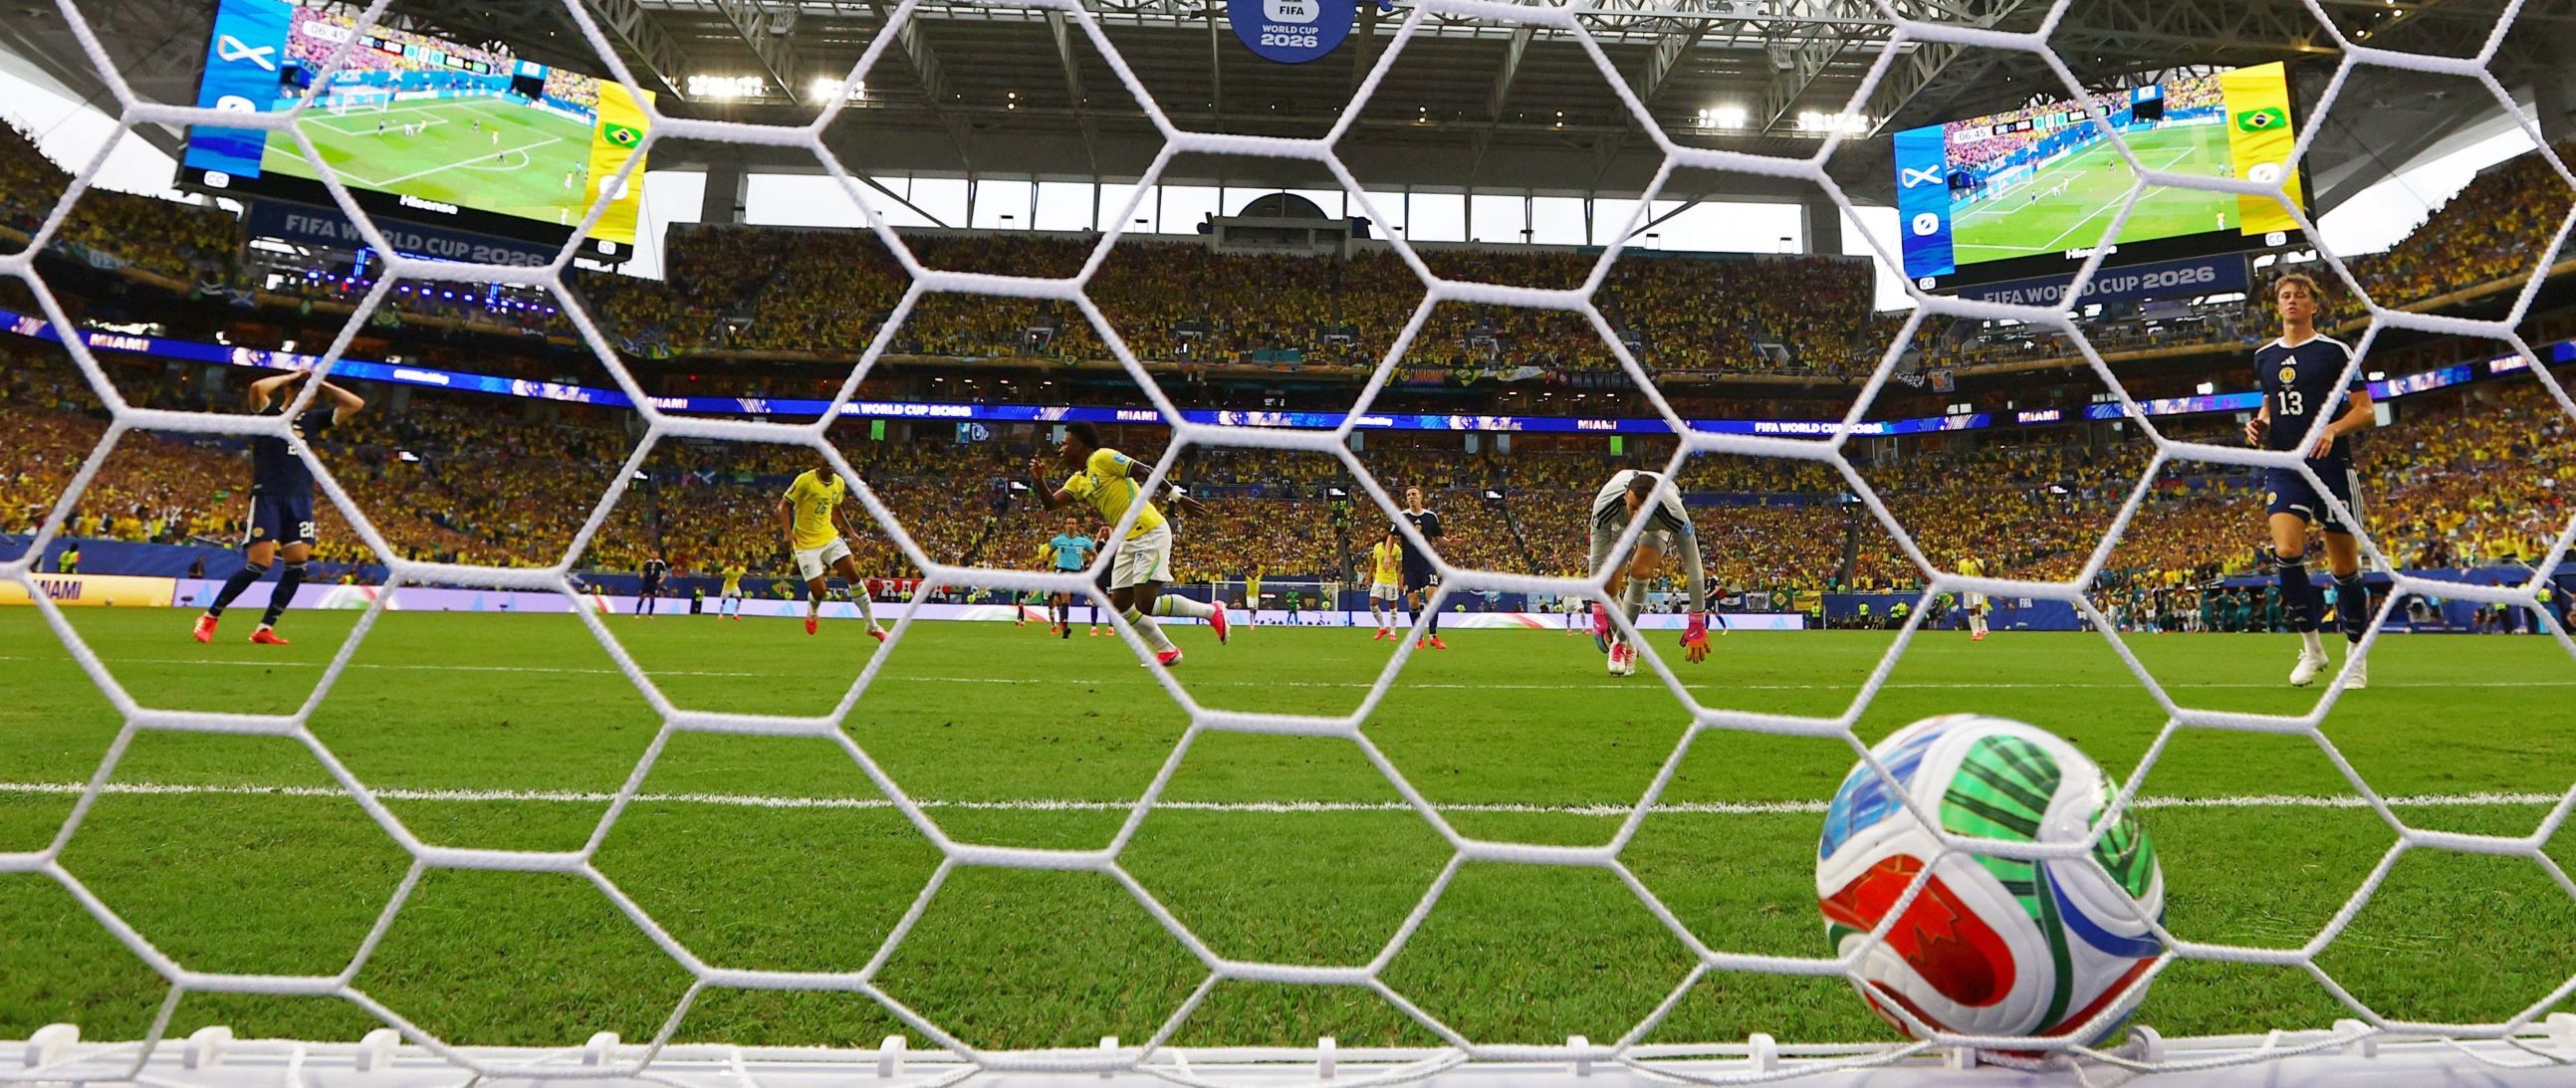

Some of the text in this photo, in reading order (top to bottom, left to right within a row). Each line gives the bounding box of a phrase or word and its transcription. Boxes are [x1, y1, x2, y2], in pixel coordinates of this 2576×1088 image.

[1280, 6, 1304, 15] FIFA
[1263, 25, 1297, 34] WORLD
[1261, 34, 1318, 48] 2026
[1959, 129, 1987, 141] 06:45
[285, 214, 545, 267] FIFA WRLD CUP 2026
[1984, 266, 2216, 305] FIFA WORD CUP 2026
[89, 332, 150, 352] MIAMI
[647, 397, 688, 409] MIAMI
[839, 403, 859, 414] IFA
[860, 403, 903, 415] WORLD
[904, 405, 929, 415] CUP
[2277, 391, 2304, 416] 13
[1116, 410, 1158, 421] MIAMI
[2018, 410, 2059, 422] MIAMI
[1755, 422, 1778, 433] FIFA
[1779, 422, 1821, 433] WORLD
[1821, 423, 1843, 433] CUP
[815, 502, 829, 516] 26
[1429, 574, 1440, 587] 19
[2019, 597, 2033, 608] FIFA
